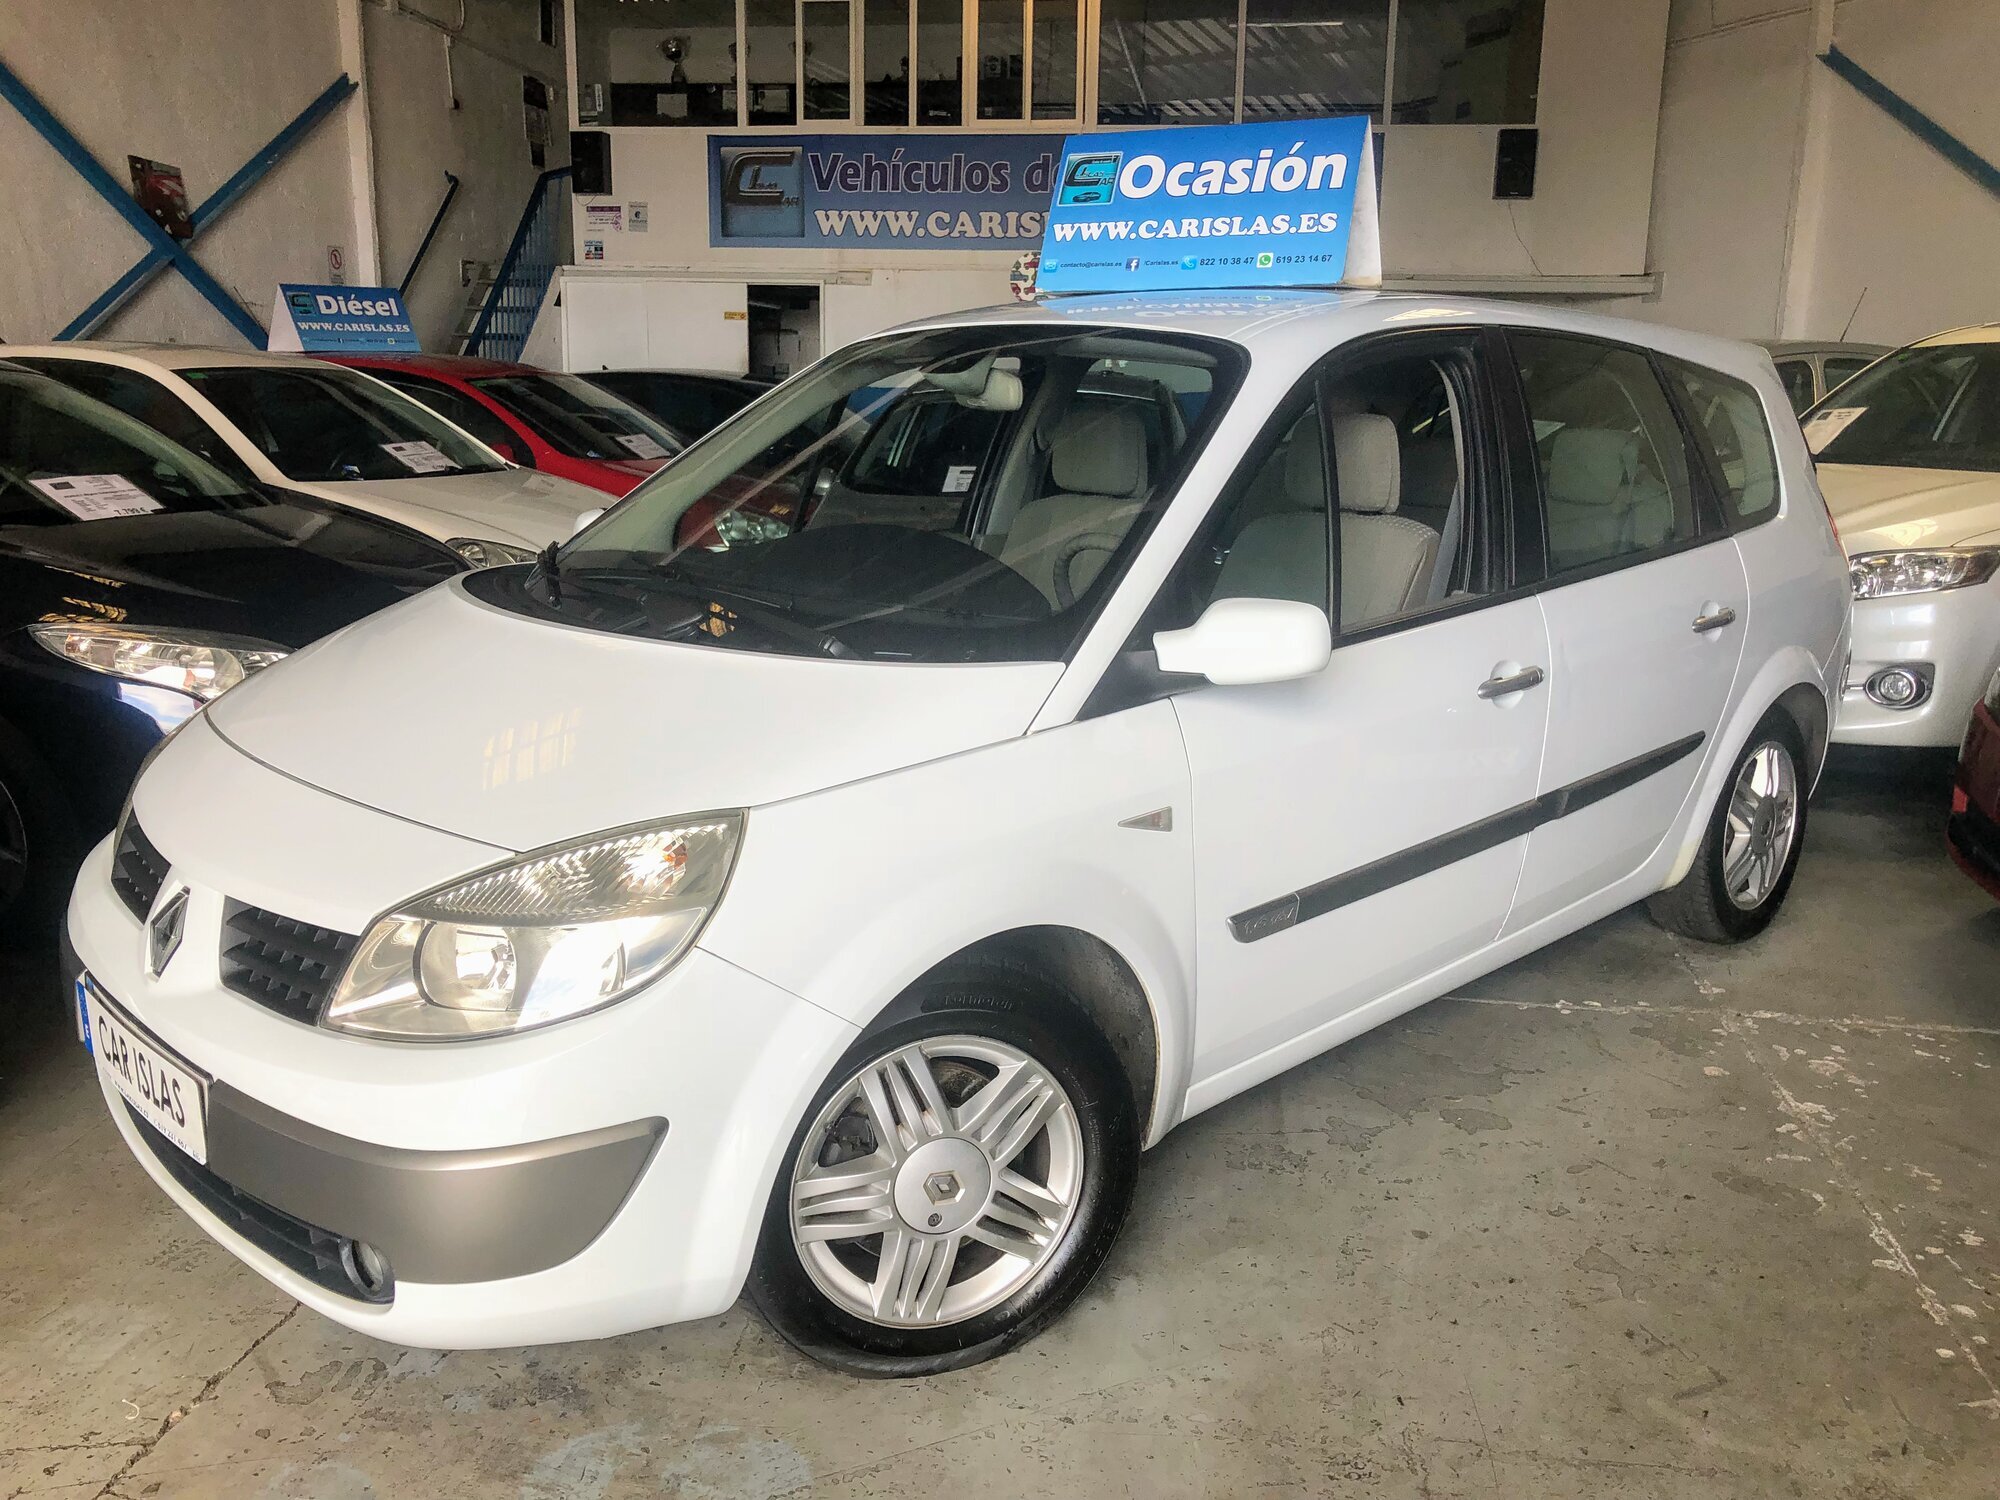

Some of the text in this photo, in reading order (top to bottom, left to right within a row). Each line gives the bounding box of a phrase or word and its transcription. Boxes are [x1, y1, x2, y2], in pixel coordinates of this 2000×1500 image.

[808, 147, 1011, 194] Vehículos
[1023, 153, 1060, 194] d
[1118, 141, 1348, 199] Ocasión
[814, 209, 1049, 239] WWW.CARIS
[1052, 211, 1338, 242] WWW.CARISLAS.ES
[1200, 256, 1254, 266] 822 10 38 47
[1276, 254, 1332, 264] 619 23 14 67
[315, 294, 400, 316] Diésel
[298, 321, 411, 333] WWW.CARISLAS.ES
[98, 1015, 185, 1128] CAR ISLAS
